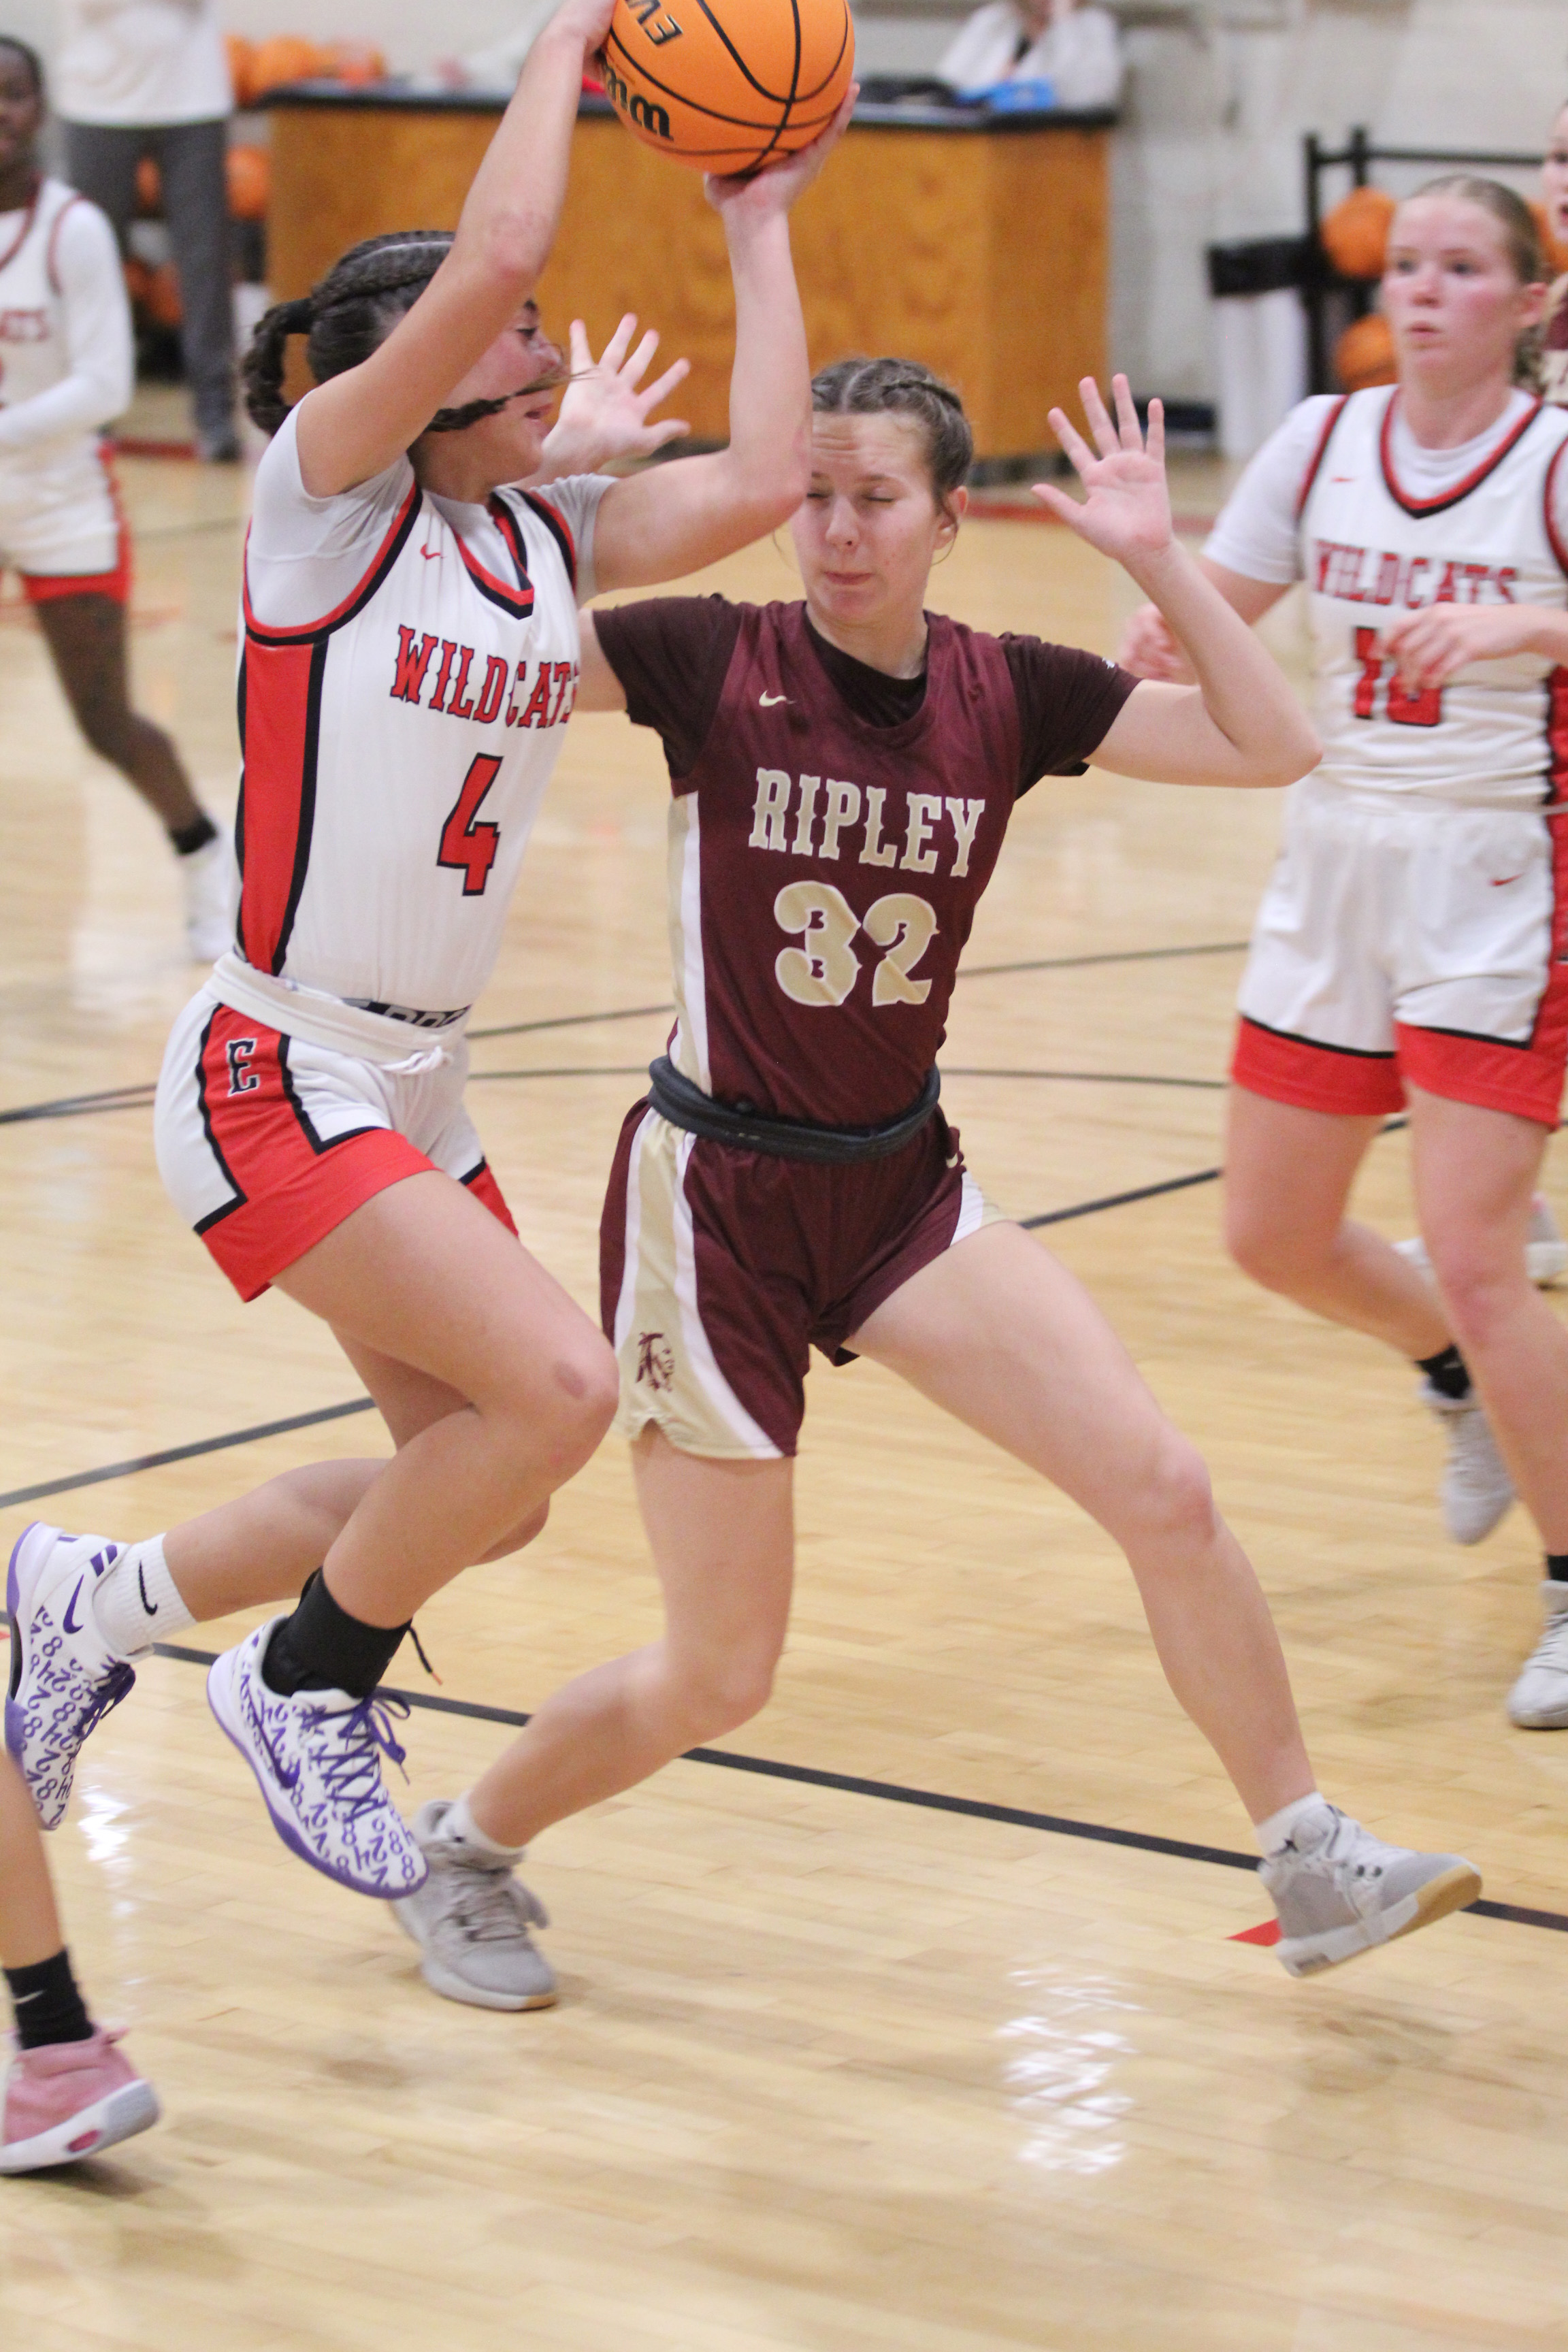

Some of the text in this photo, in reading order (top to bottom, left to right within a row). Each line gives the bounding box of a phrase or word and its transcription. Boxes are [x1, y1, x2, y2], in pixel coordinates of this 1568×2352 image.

[436, 752, 504, 896] 4
[748, 767, 985, 877] RIPLEY
[773, 880, 941, 1007] 32
[227, 1038, 259, 1097] E
